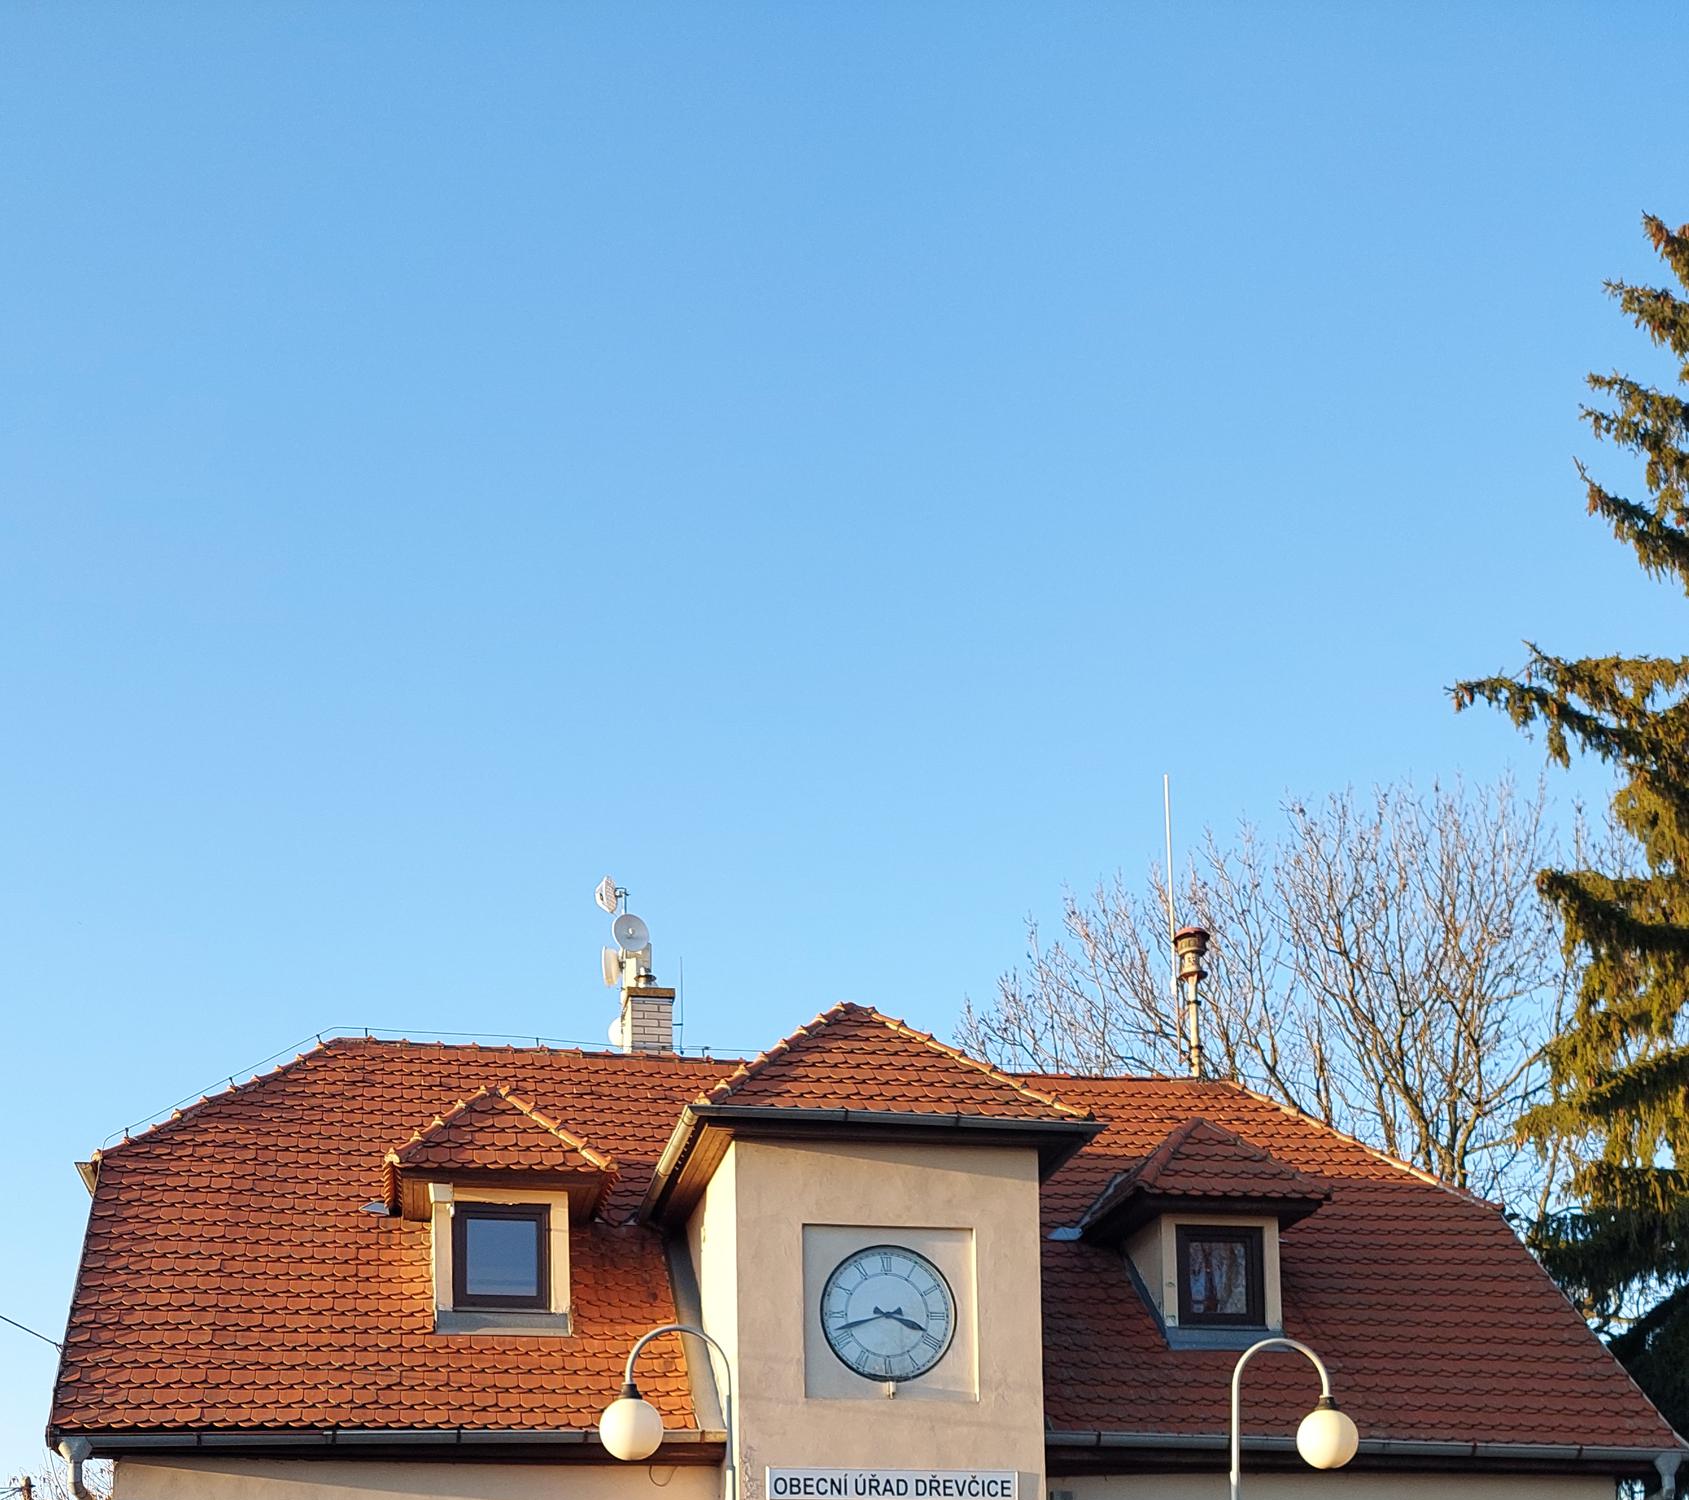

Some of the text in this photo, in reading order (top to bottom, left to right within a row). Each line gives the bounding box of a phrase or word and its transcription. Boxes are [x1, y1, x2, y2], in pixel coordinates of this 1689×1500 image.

[880, 1256, 892, 1272] XII
[929, 1311, 945, 1320] III
[773, 1473, 1012, 1498] OBECNÍ ÚŘAD DŘEVČICE
